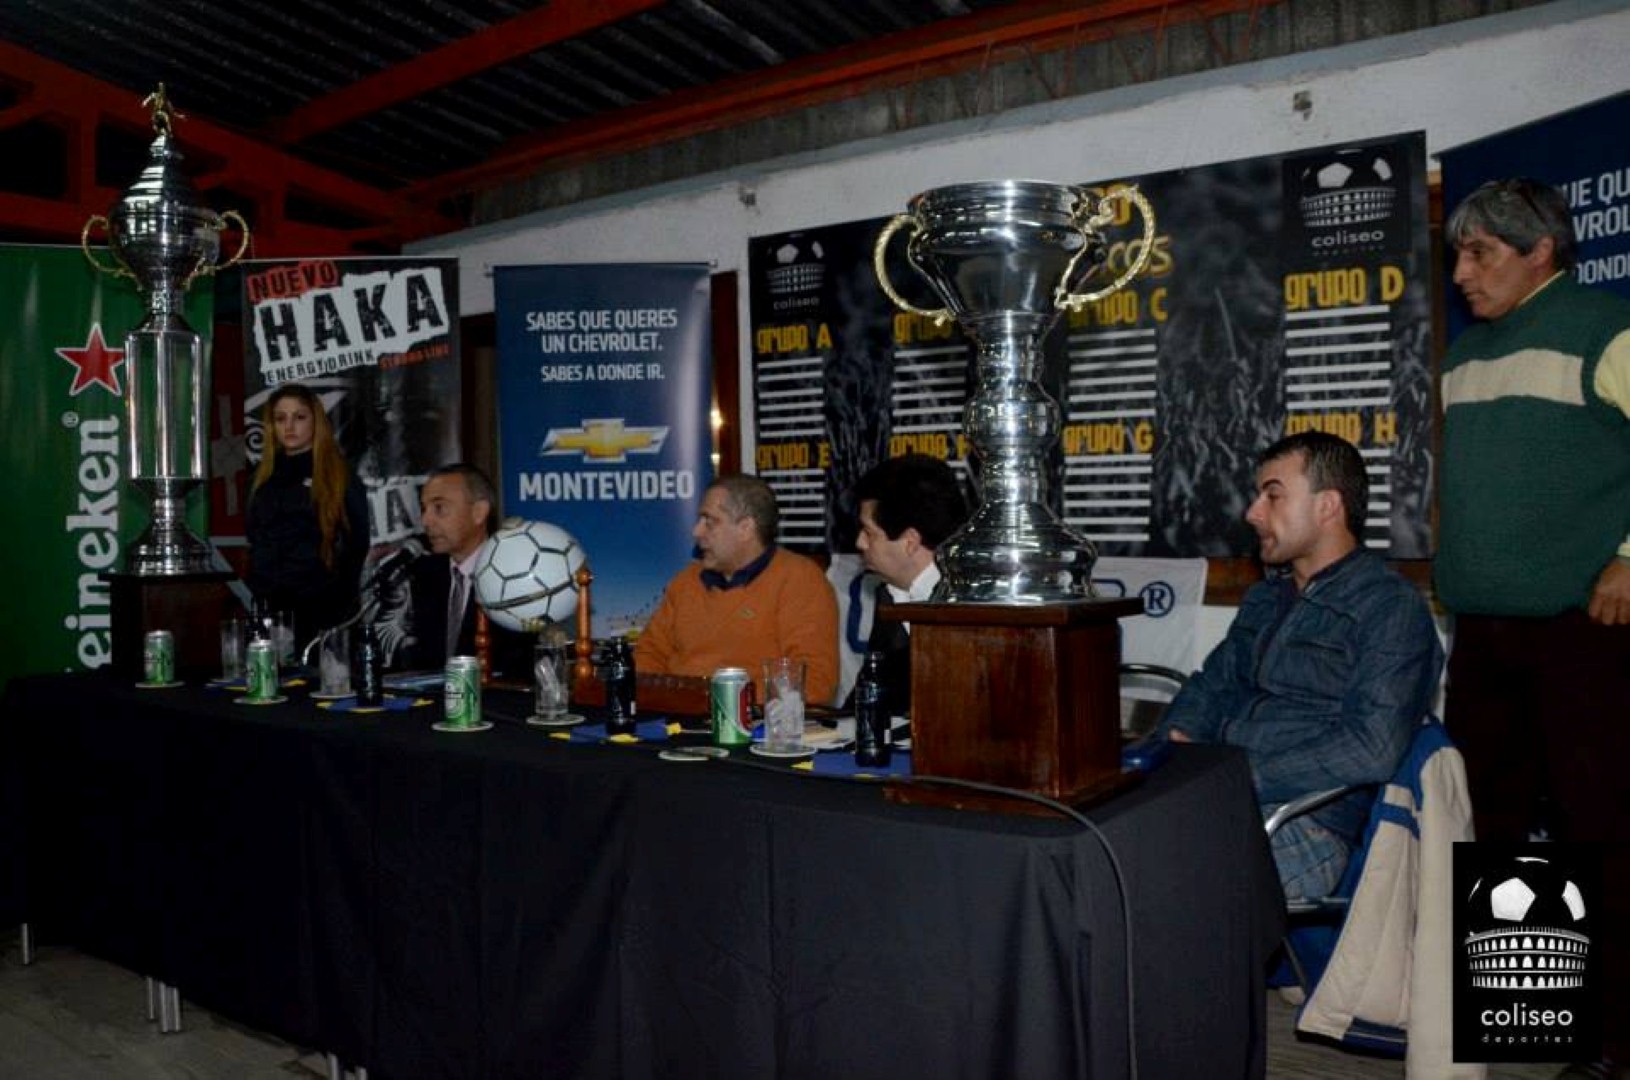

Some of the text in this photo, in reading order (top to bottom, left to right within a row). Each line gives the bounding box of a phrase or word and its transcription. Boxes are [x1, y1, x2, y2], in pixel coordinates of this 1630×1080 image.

[1311, 230, 1384, 248] coliseo
[250, 262, 335, 300] NUEVO
[1284, 265, 1405, 310] grupo D
[260, 273, 444, 362] HAKA
[1149, 287, 1168, 323] C
[526, 309, 678, 333] SABES QUE QUERES
[816, 321, 833, 351] A
[541, 331, 664, 354] UN CHEVROLET.
[541, 363, 666, 383] SABES A DONDE IR.
[1134, 420, 1155, 452] G
[1373, 411, 1397, 442] H
[817, 441, 833, 469] E
[519, 470, 696, 502] MONTEVIDEO
[65, 413, 120, 670] eineken
